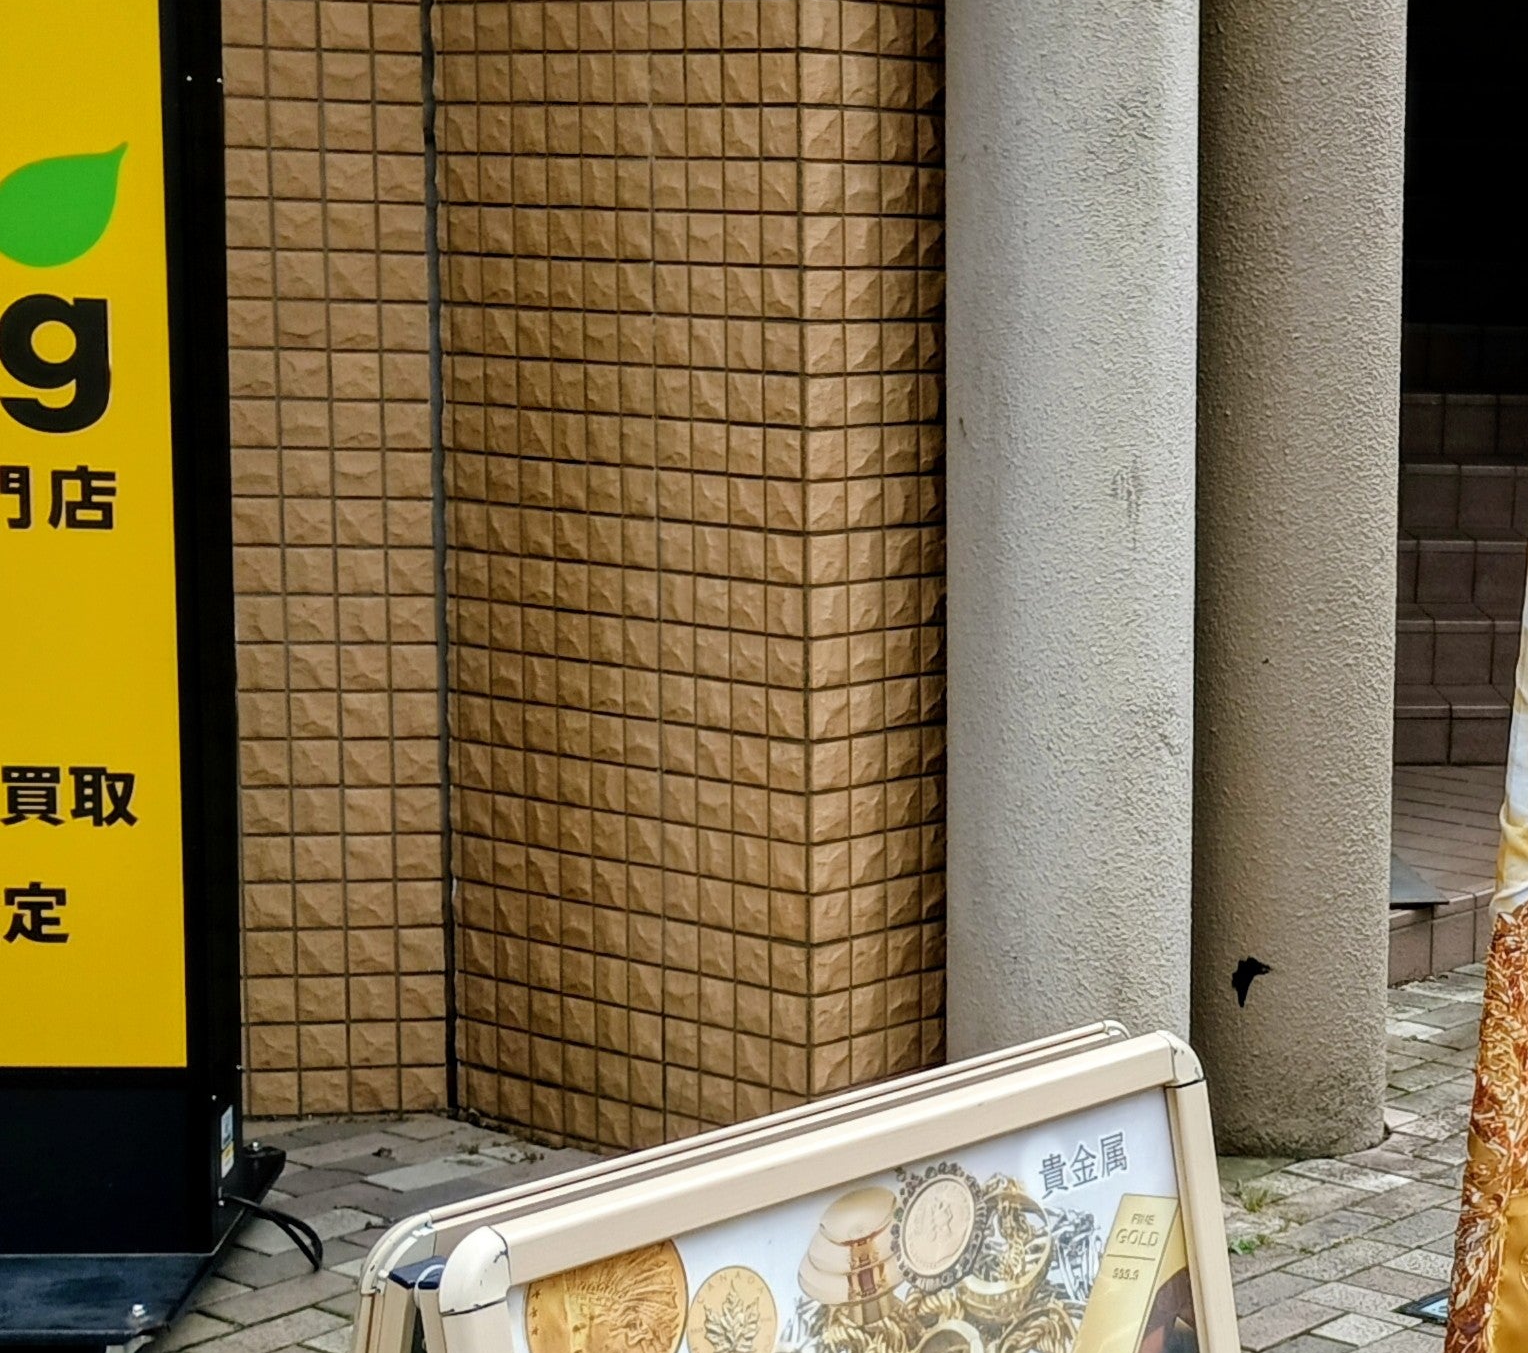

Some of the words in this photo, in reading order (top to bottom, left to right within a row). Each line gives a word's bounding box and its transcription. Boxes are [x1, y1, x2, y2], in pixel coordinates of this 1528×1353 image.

[0, 765, 139, 828] 買取
[3, 881, 70, 944] 定
[1038, 1131, 1128, 1200] 貴金属
[1115, 1227, 1160, 1248] GOLD
